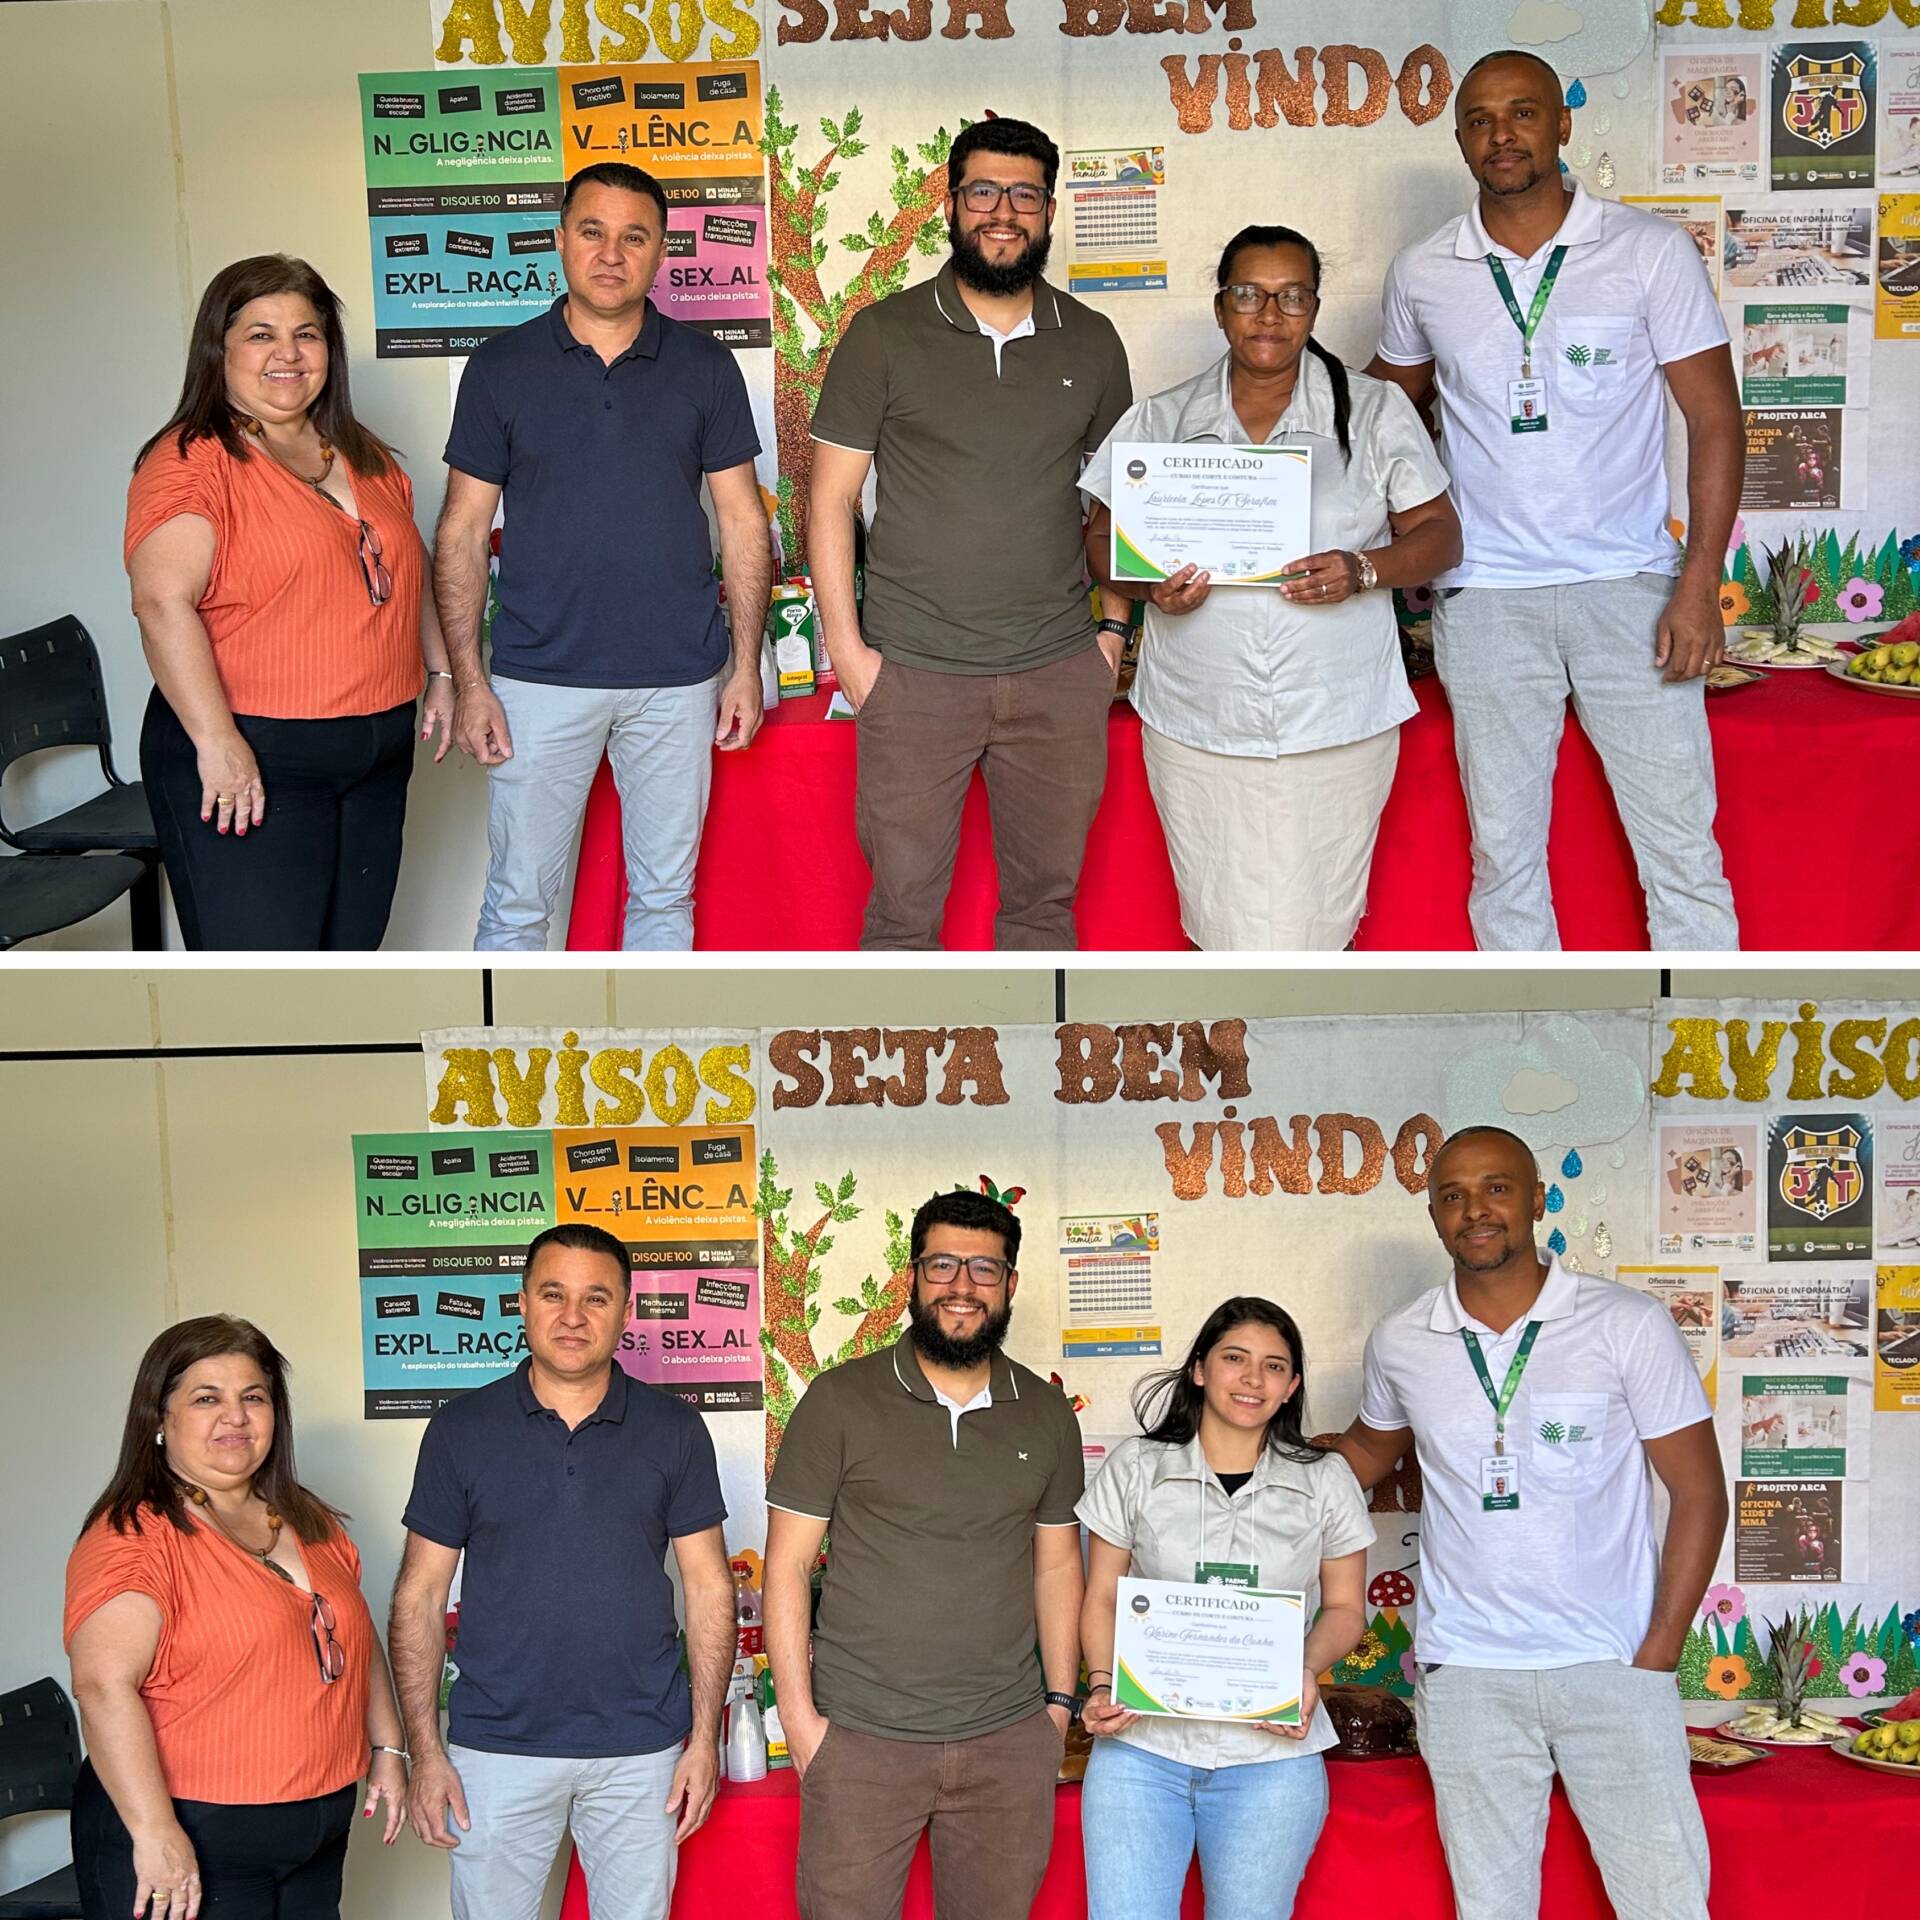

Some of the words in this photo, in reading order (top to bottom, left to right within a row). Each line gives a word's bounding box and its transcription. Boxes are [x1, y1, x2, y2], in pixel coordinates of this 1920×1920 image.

[713, 80, 731, 88] Fuga
[579, 87, 601, 95] Choro
[601, 84, 617, 92] sem
[587, 93, 611, 101] motivo
[641, 92, 679, 100] Isolamento
[444, 156, 496, 167] negligência
[498, 156, 522, 164] deixa
[524, 155, 554, 165] pistas.
[660, 152, 699, 161] violência
[725, 152, 753, 162] pistas.
[714, 218, 748, 228] Infecções
[1742, 216, 1778, 224] OFICINA
[1794, 214, 1853, 223] INFORMÁTICA
[708, 225, 751, 236] sexualmente
[458, 237, 472, 245] Falta
[705, 232, 752, 244] transmissíveis
[448, 243, 489, 255] concentração
[732, 292, 759, 302] pistas.
[1757, 412, 1798, 421] PROJETO
[1163, 457, 1263, 469] CERTIFICADO
[768, 1026, 1010, 1110] SEJA
[1054, 1018, 1251, 1104] BEM
[573, 1150, 596, 1158] Choro
[596, 1147, 611, 1155] sem
[581, 1155, 606, 1164] motivo
[635, 1155, 674, 1163] Isolamento
[437, 1218, 489, 1229] negligência
[517, 1217, 547, 1226] pistas.
[654, 1216, 692, 1224] violência
[719, 1215, 748, 1225] pistas.
[706, 1280, 741, 1291] Infecções
[1740, 1287, 1775, 1295] OFICINA
[1791, 1285, 1851, 1294] INFORMÁTICA
[700, 1288, 744, 1299] sexualmente
[384, 1301, 410, 1309] Cansaço
[449, 1298, 462, 1306] Falta
[698, 1295, 745, 1307] transmissíveis
[439, 1305, 481, 1316] concentração
[1682, 1328, 1707, 1336] rochê
[700, 1355, 723, 1363] deixa
[725, 1354, 752, 1364] pistas.
[1757, 1484, 1798, 1493] PROJETO
[1166, 1594, 1260, 1611] CERTIFICADO
